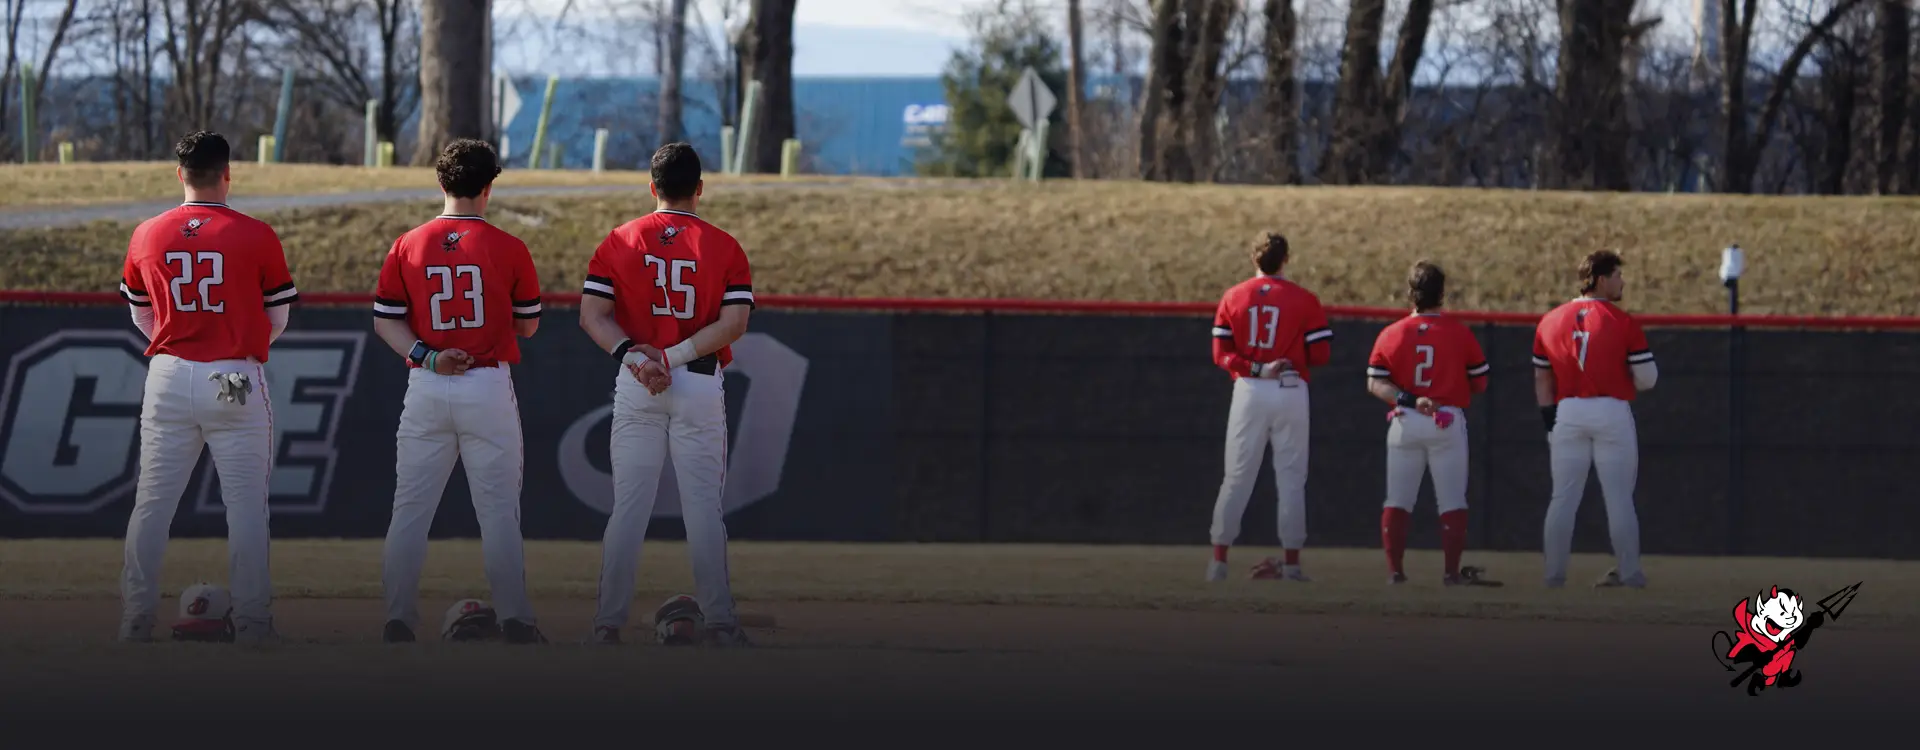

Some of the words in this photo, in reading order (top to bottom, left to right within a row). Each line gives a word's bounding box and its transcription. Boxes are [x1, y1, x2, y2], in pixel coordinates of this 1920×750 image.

[165, 251, 224, 313] 22
[426, 264, 484, 330] 23
[644, 254, 697, 319] 35
[1248, 304, 1280, 349] 13
[1572, 330, 1590, 372] 7
[1415, 344, 1434, 387] 2
